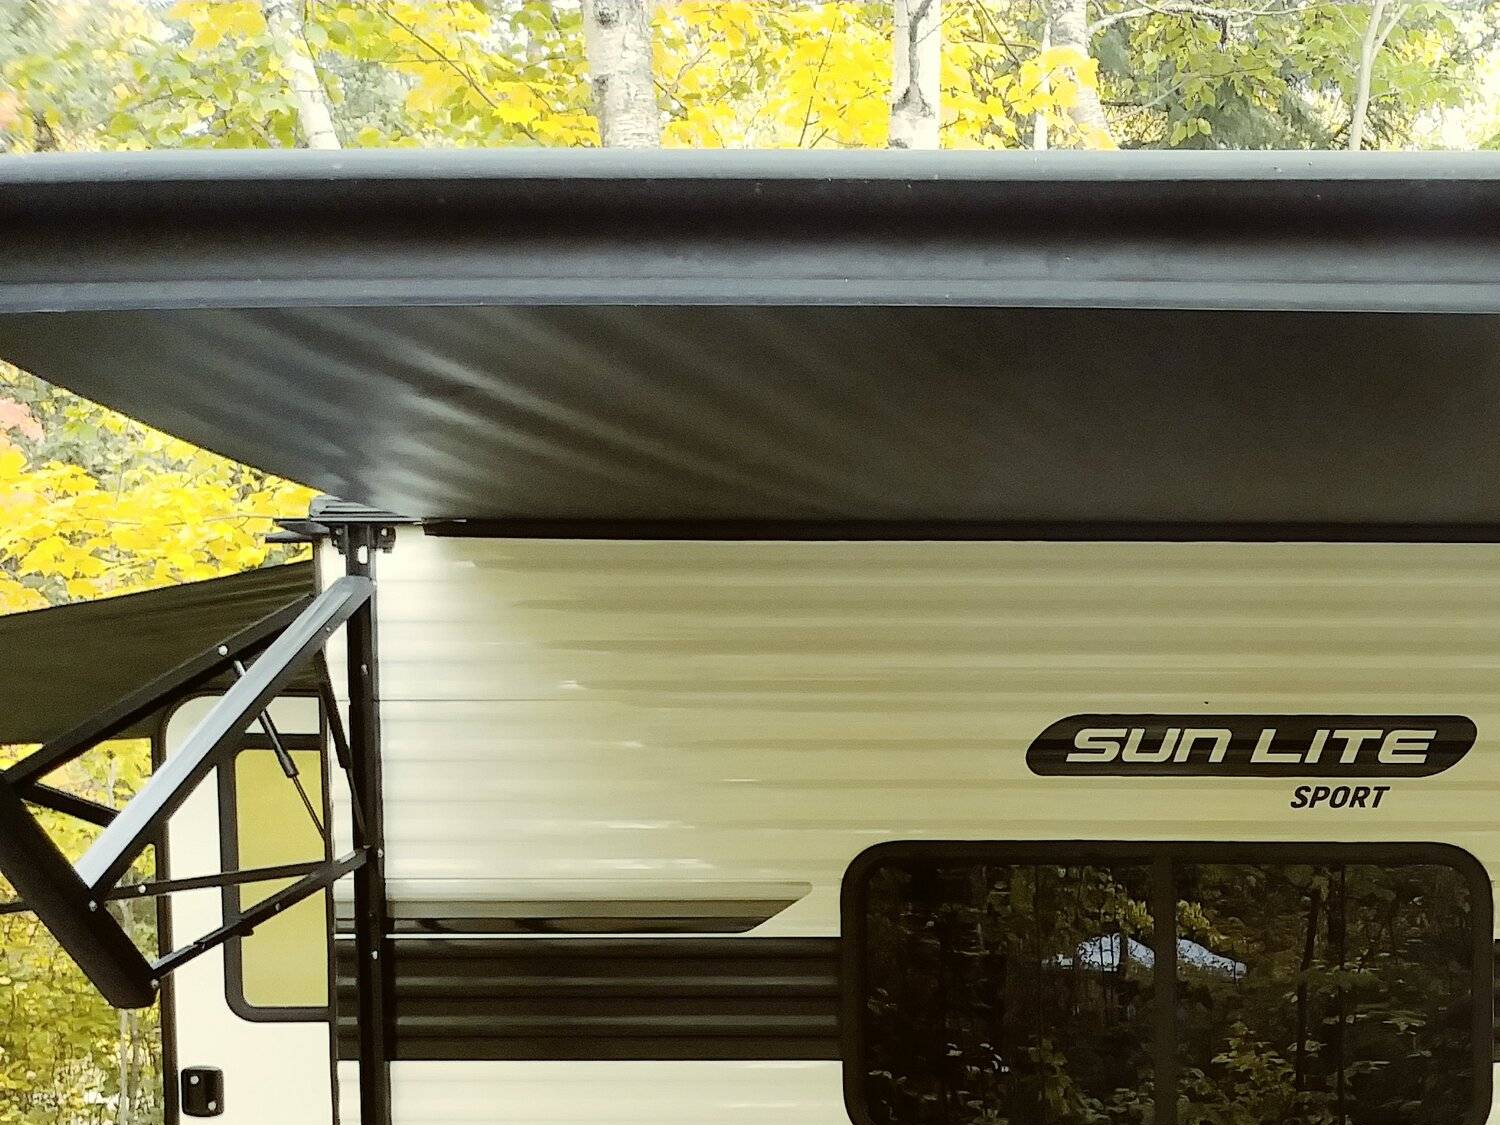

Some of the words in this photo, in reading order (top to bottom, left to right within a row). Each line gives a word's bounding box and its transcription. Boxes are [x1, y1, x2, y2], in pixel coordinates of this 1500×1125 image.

[1066, 728, 1232, 763] SUN
[1250, 729, 1437, 764] LITE
[1291, 785, 1391, 808] SPORT
